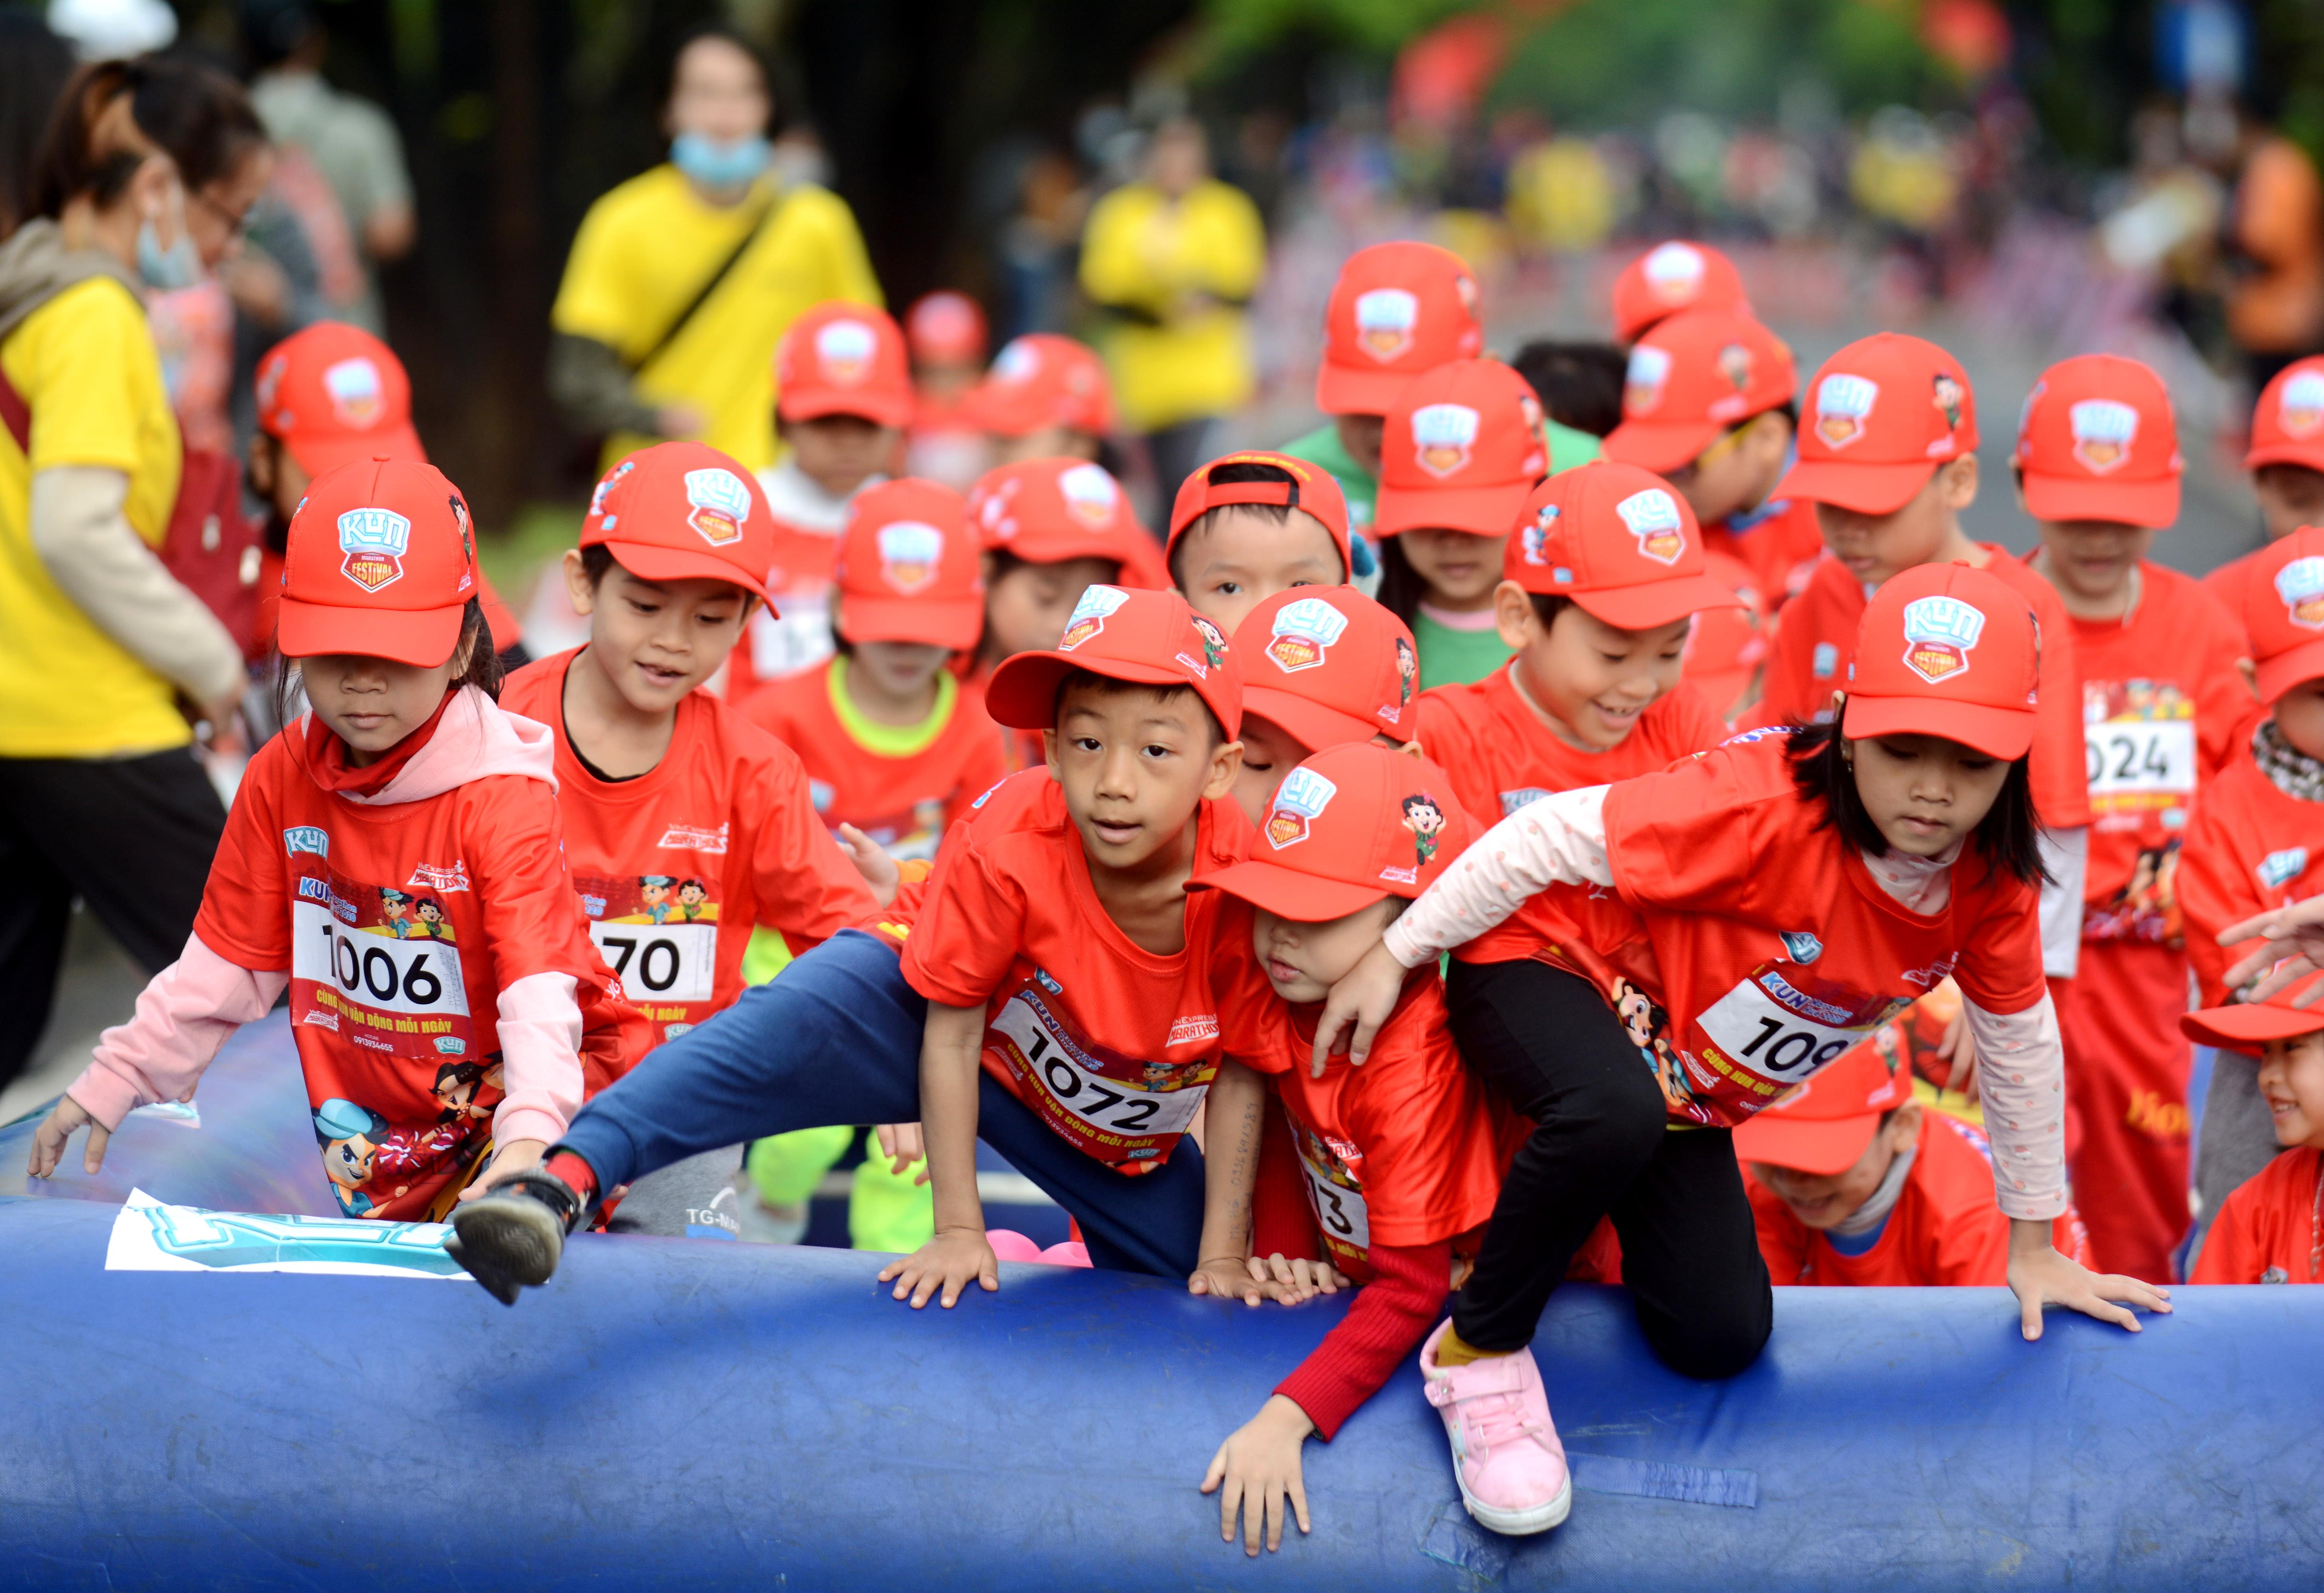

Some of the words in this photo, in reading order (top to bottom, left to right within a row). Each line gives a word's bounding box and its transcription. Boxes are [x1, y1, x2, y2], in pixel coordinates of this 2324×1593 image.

[341, 512, 407, 551] KUN
[1908, 600, 1979, 644] KUN
[322, 924, 442, 1005] 1006
[1020, 988, 1061, 1032] KUN
[1759, 971, 1811, 1010] KUN
[367, 1012, 394, 1032] ĐỘNG
[395, 1016, 419, 1033] MỖI
[421, 1018, 452, 1034] NGÀY
[354, 1035, 394, 1052] 0913934655
[1028, 1025, 1160, 1131] 1072
[1701, 1048, 1733, 1076] CÙNG
[1729, 1069, 1755, 1090] KUN
[1064, 1114, 1096, 1138] ĐỘNG
[1096, 1133, 1123, 1147] MỖI
[1123, 1138, 1155, 1148] NGÀY
